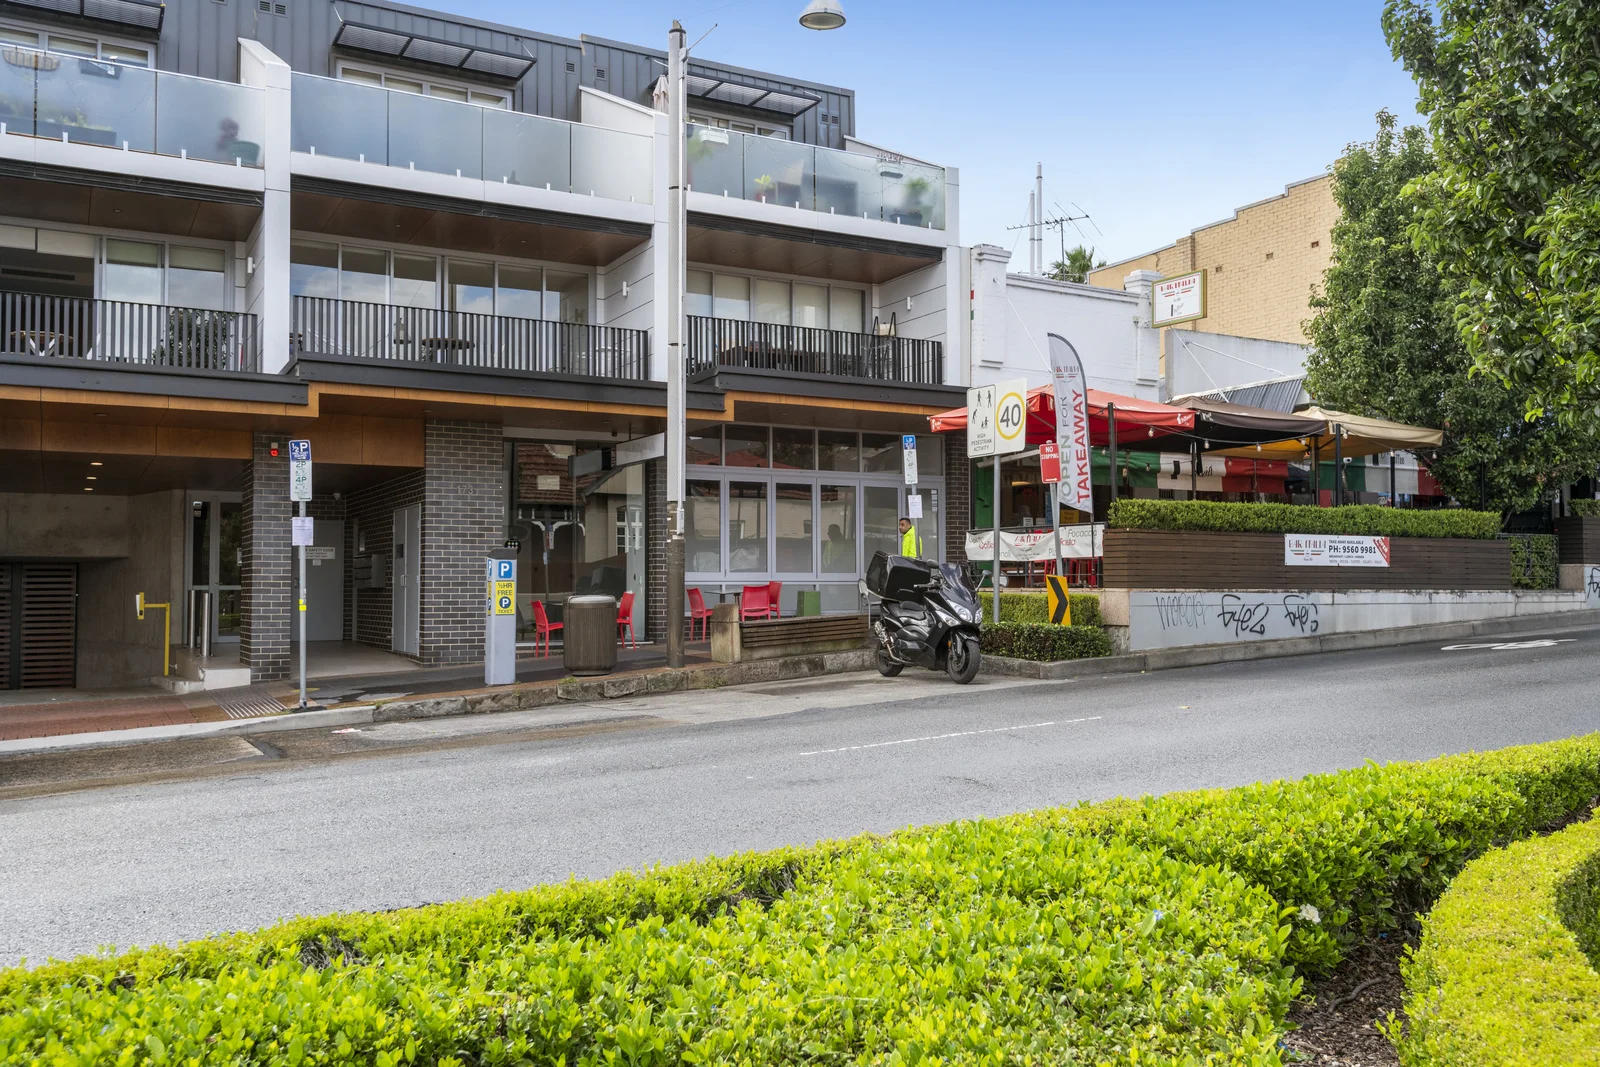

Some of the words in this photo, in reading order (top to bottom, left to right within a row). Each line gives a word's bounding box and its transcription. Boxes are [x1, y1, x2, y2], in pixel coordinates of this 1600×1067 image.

[1000, 403, 1021, 428] 40
[1060, 396, 1069, 427] FOR
[970, 438, 992, 446] PEDESTRIAN
[973, 444, 989, 452] ACTIVITY
[1072, 389, 1090, 503] TAKEAWAY
[1060, 434, 1072, 497] OPEN
[457, 484, 474, 495] 173
[1328, 545, 1341, 553] PH:
[1342, 545, 1359, 554] 9560
[1359, 546, 1377, 554] 9981
[500, 563, 510, 577] P
[502, 598, 510, 608] P
